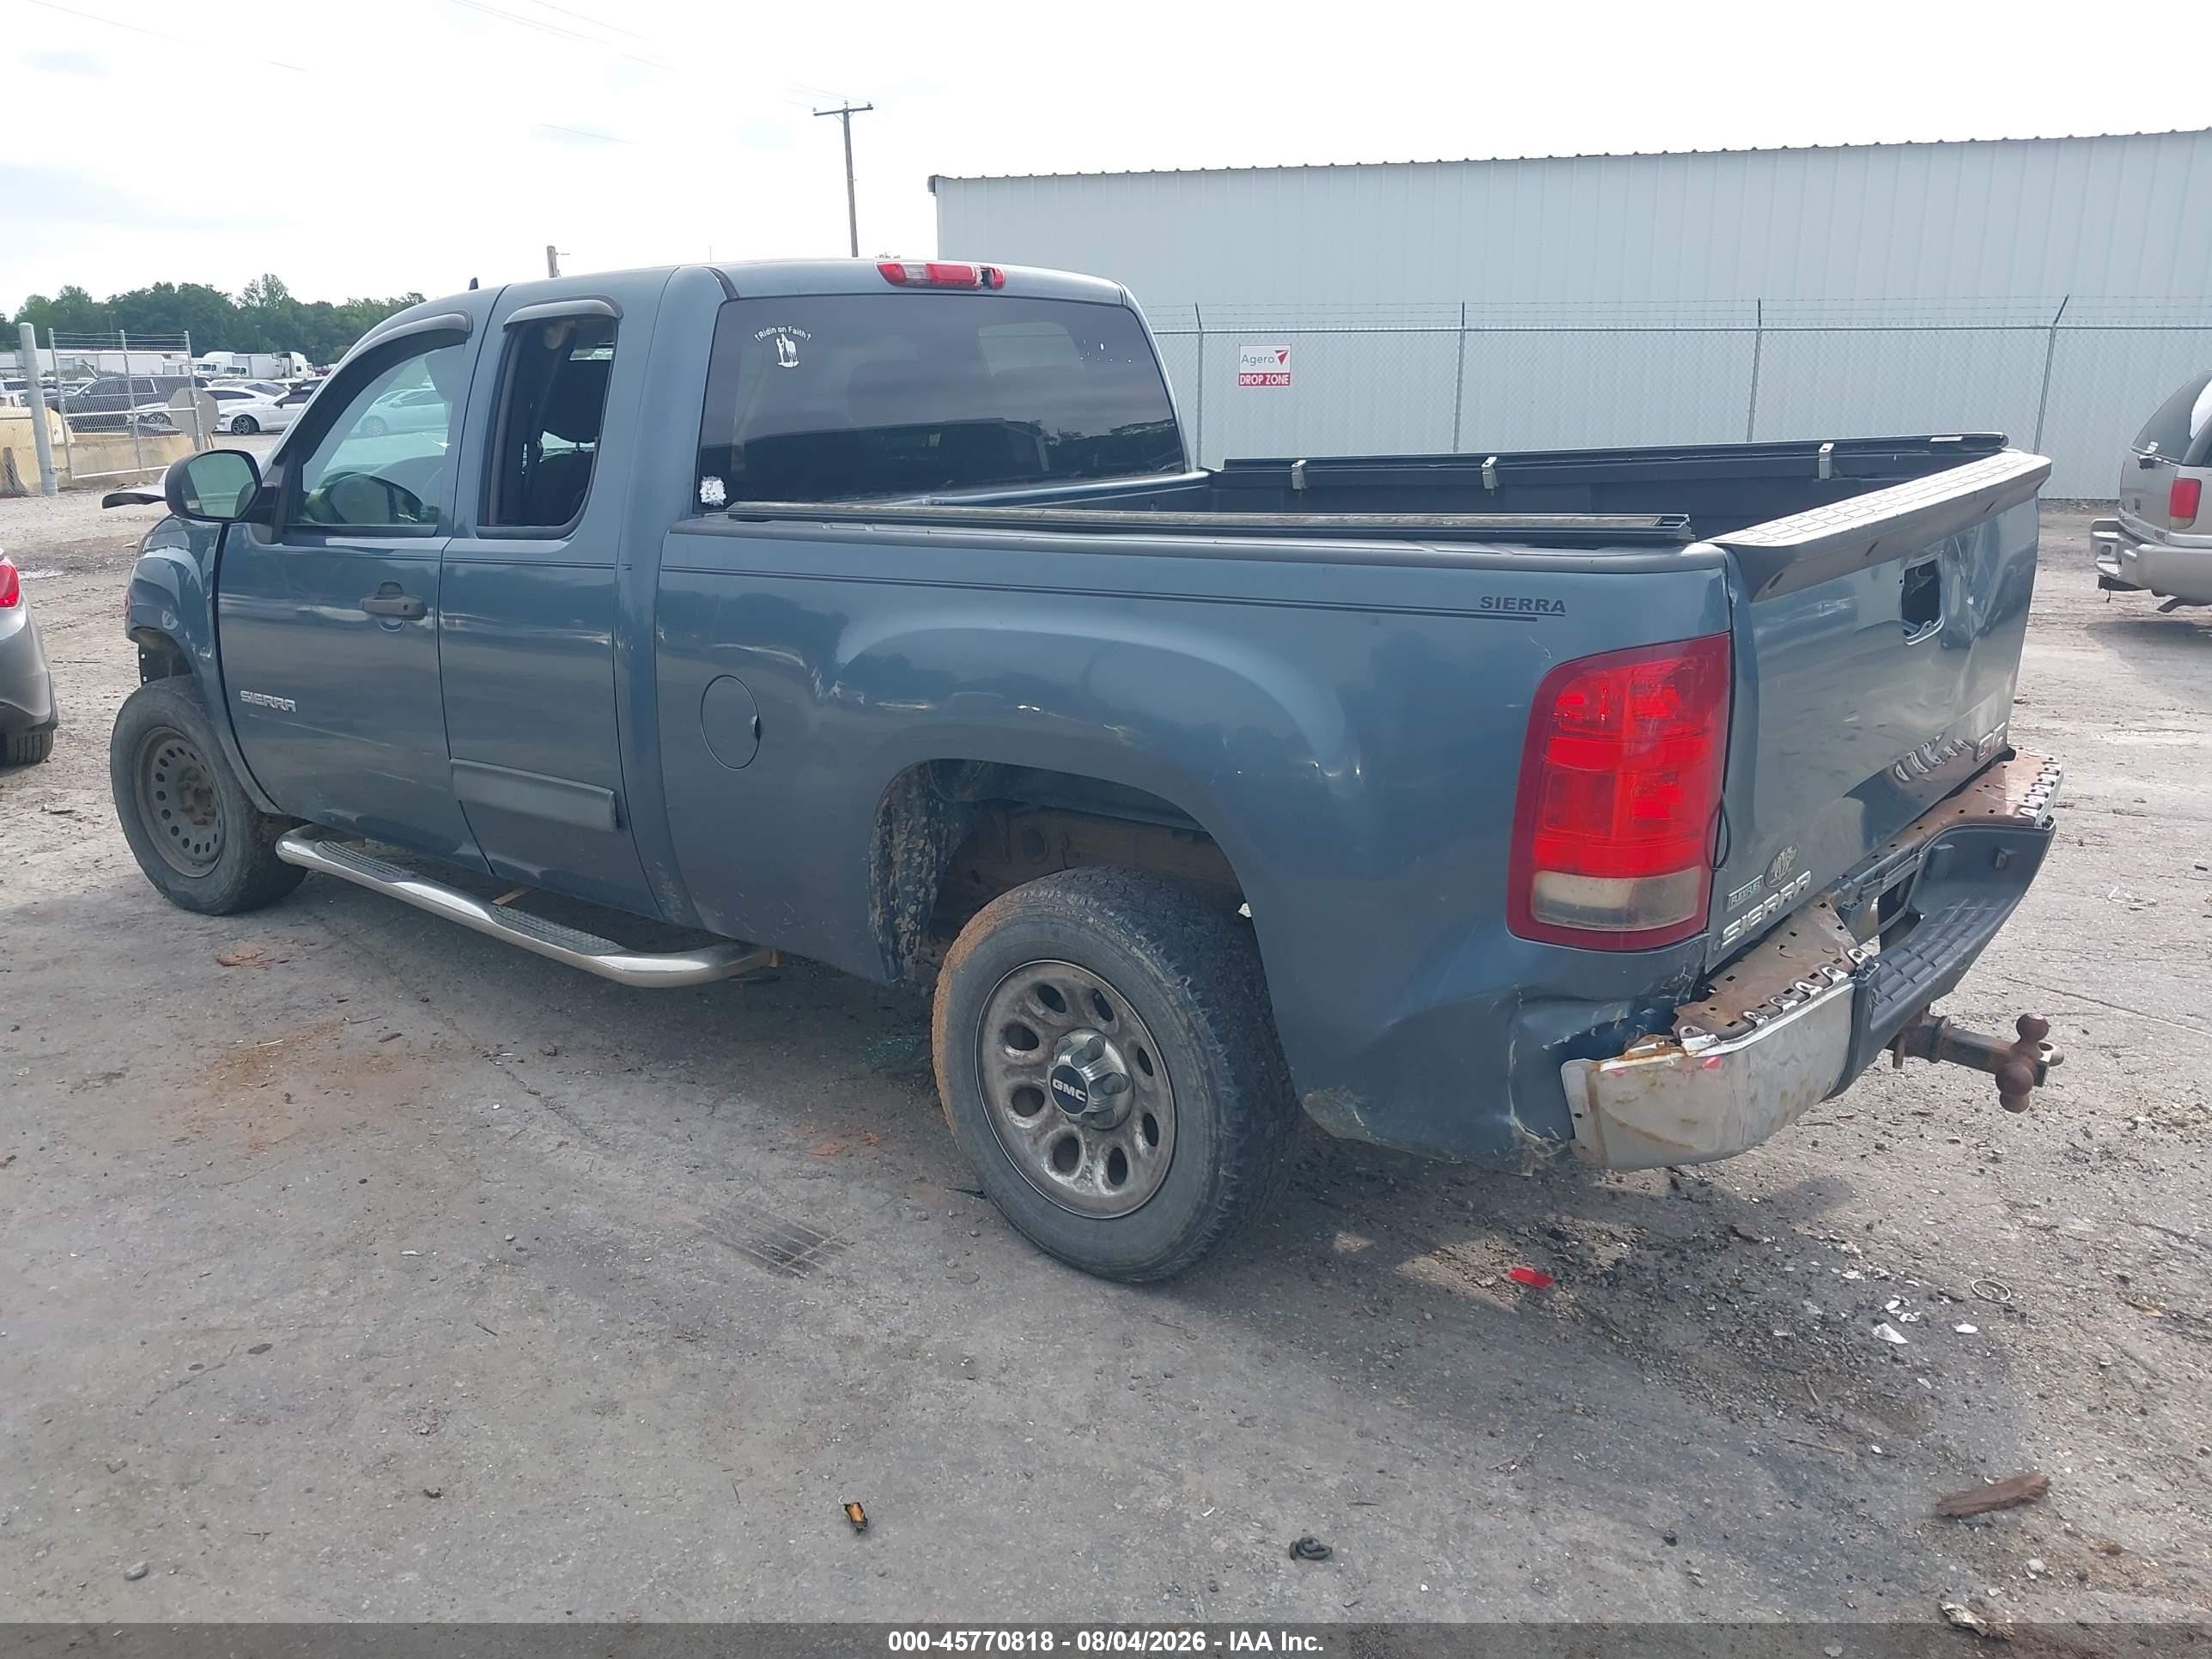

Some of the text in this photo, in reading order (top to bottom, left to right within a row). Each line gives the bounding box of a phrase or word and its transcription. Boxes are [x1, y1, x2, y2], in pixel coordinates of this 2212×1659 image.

[758, 326, 777, 339] Ridin
[787, 325, 806, 339] Faith
[1241, 354, 1275, 367] Agero
[1239, 374, 1290, 386] DROP ZONE
[1480, 596, 1566, 612] SIERRA
[240, 690, 296, 713] SIERRA
[1721, 870, 1812, 950] SIERRA
[1052, 1079, 1086, 1102] GMC
